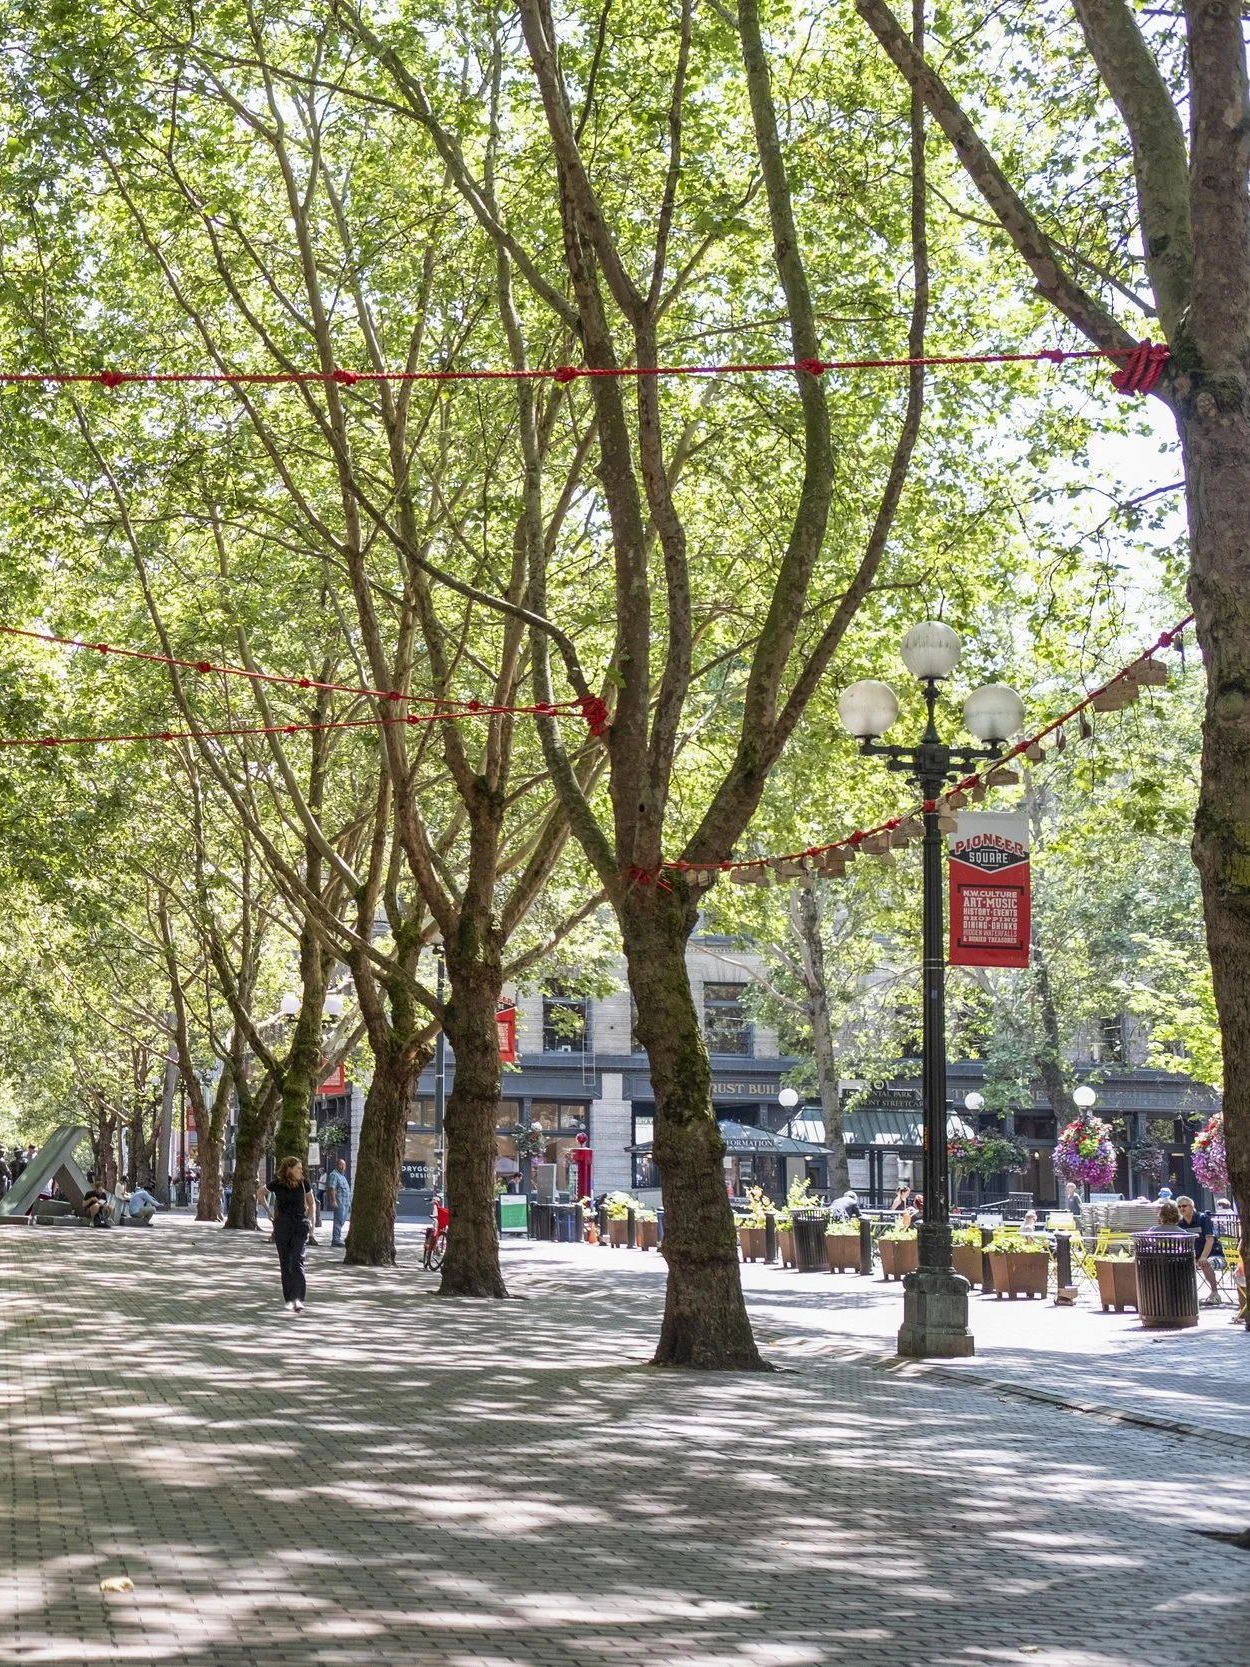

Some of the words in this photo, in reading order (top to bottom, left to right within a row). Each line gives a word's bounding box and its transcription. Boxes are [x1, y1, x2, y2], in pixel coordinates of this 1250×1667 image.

[955, 833, 1025, 857] PIONEER
[969, 852, 1008, 863] SQUARE
[893, 1090, 912, 1098] PARK
